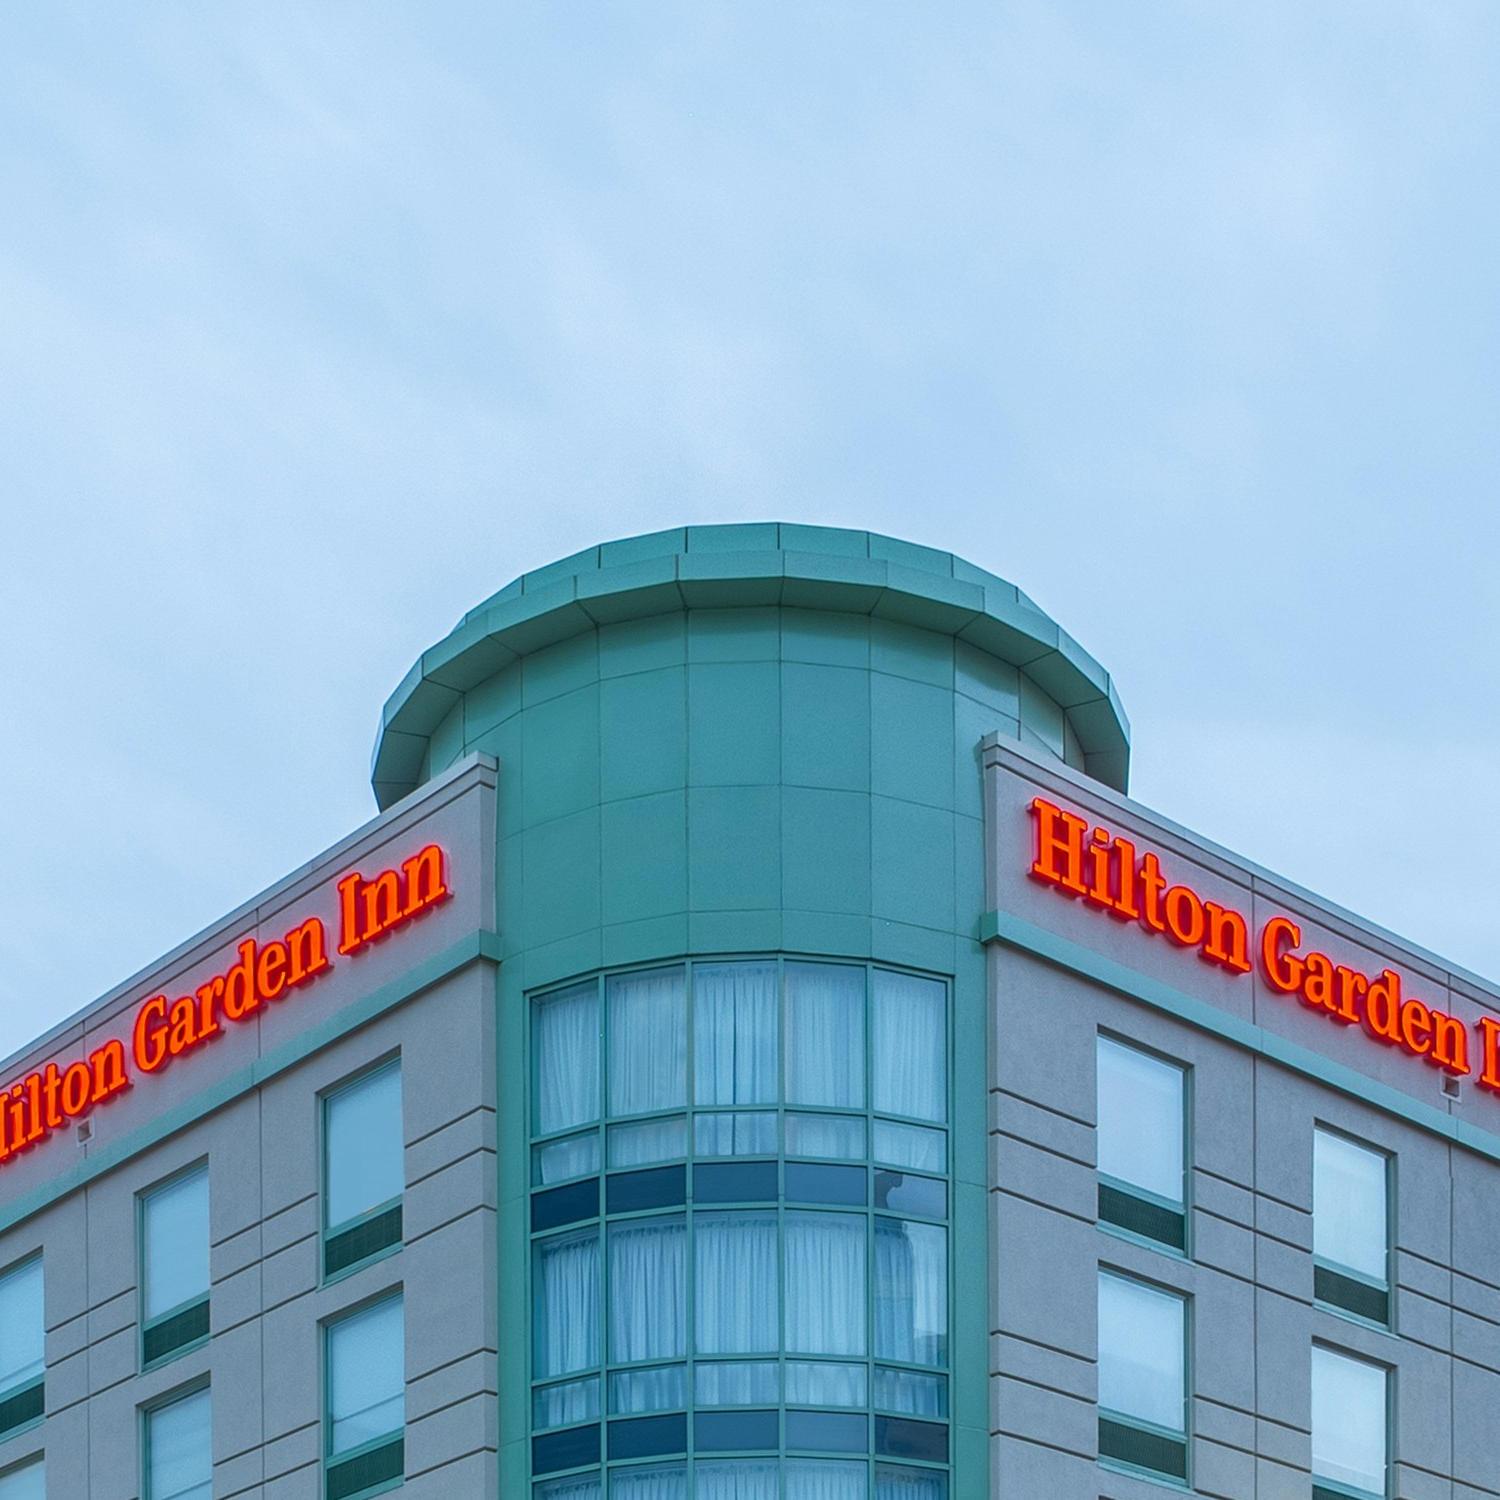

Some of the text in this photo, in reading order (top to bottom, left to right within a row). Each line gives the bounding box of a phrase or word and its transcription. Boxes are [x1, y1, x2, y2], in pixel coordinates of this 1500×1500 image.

[131, 917, 328, 1073] Garden
[336, 843, 447, 956] Inn
[1032, 797, 1253, 974] Hilton
[1262, 917, 1472, 1075] Garden
